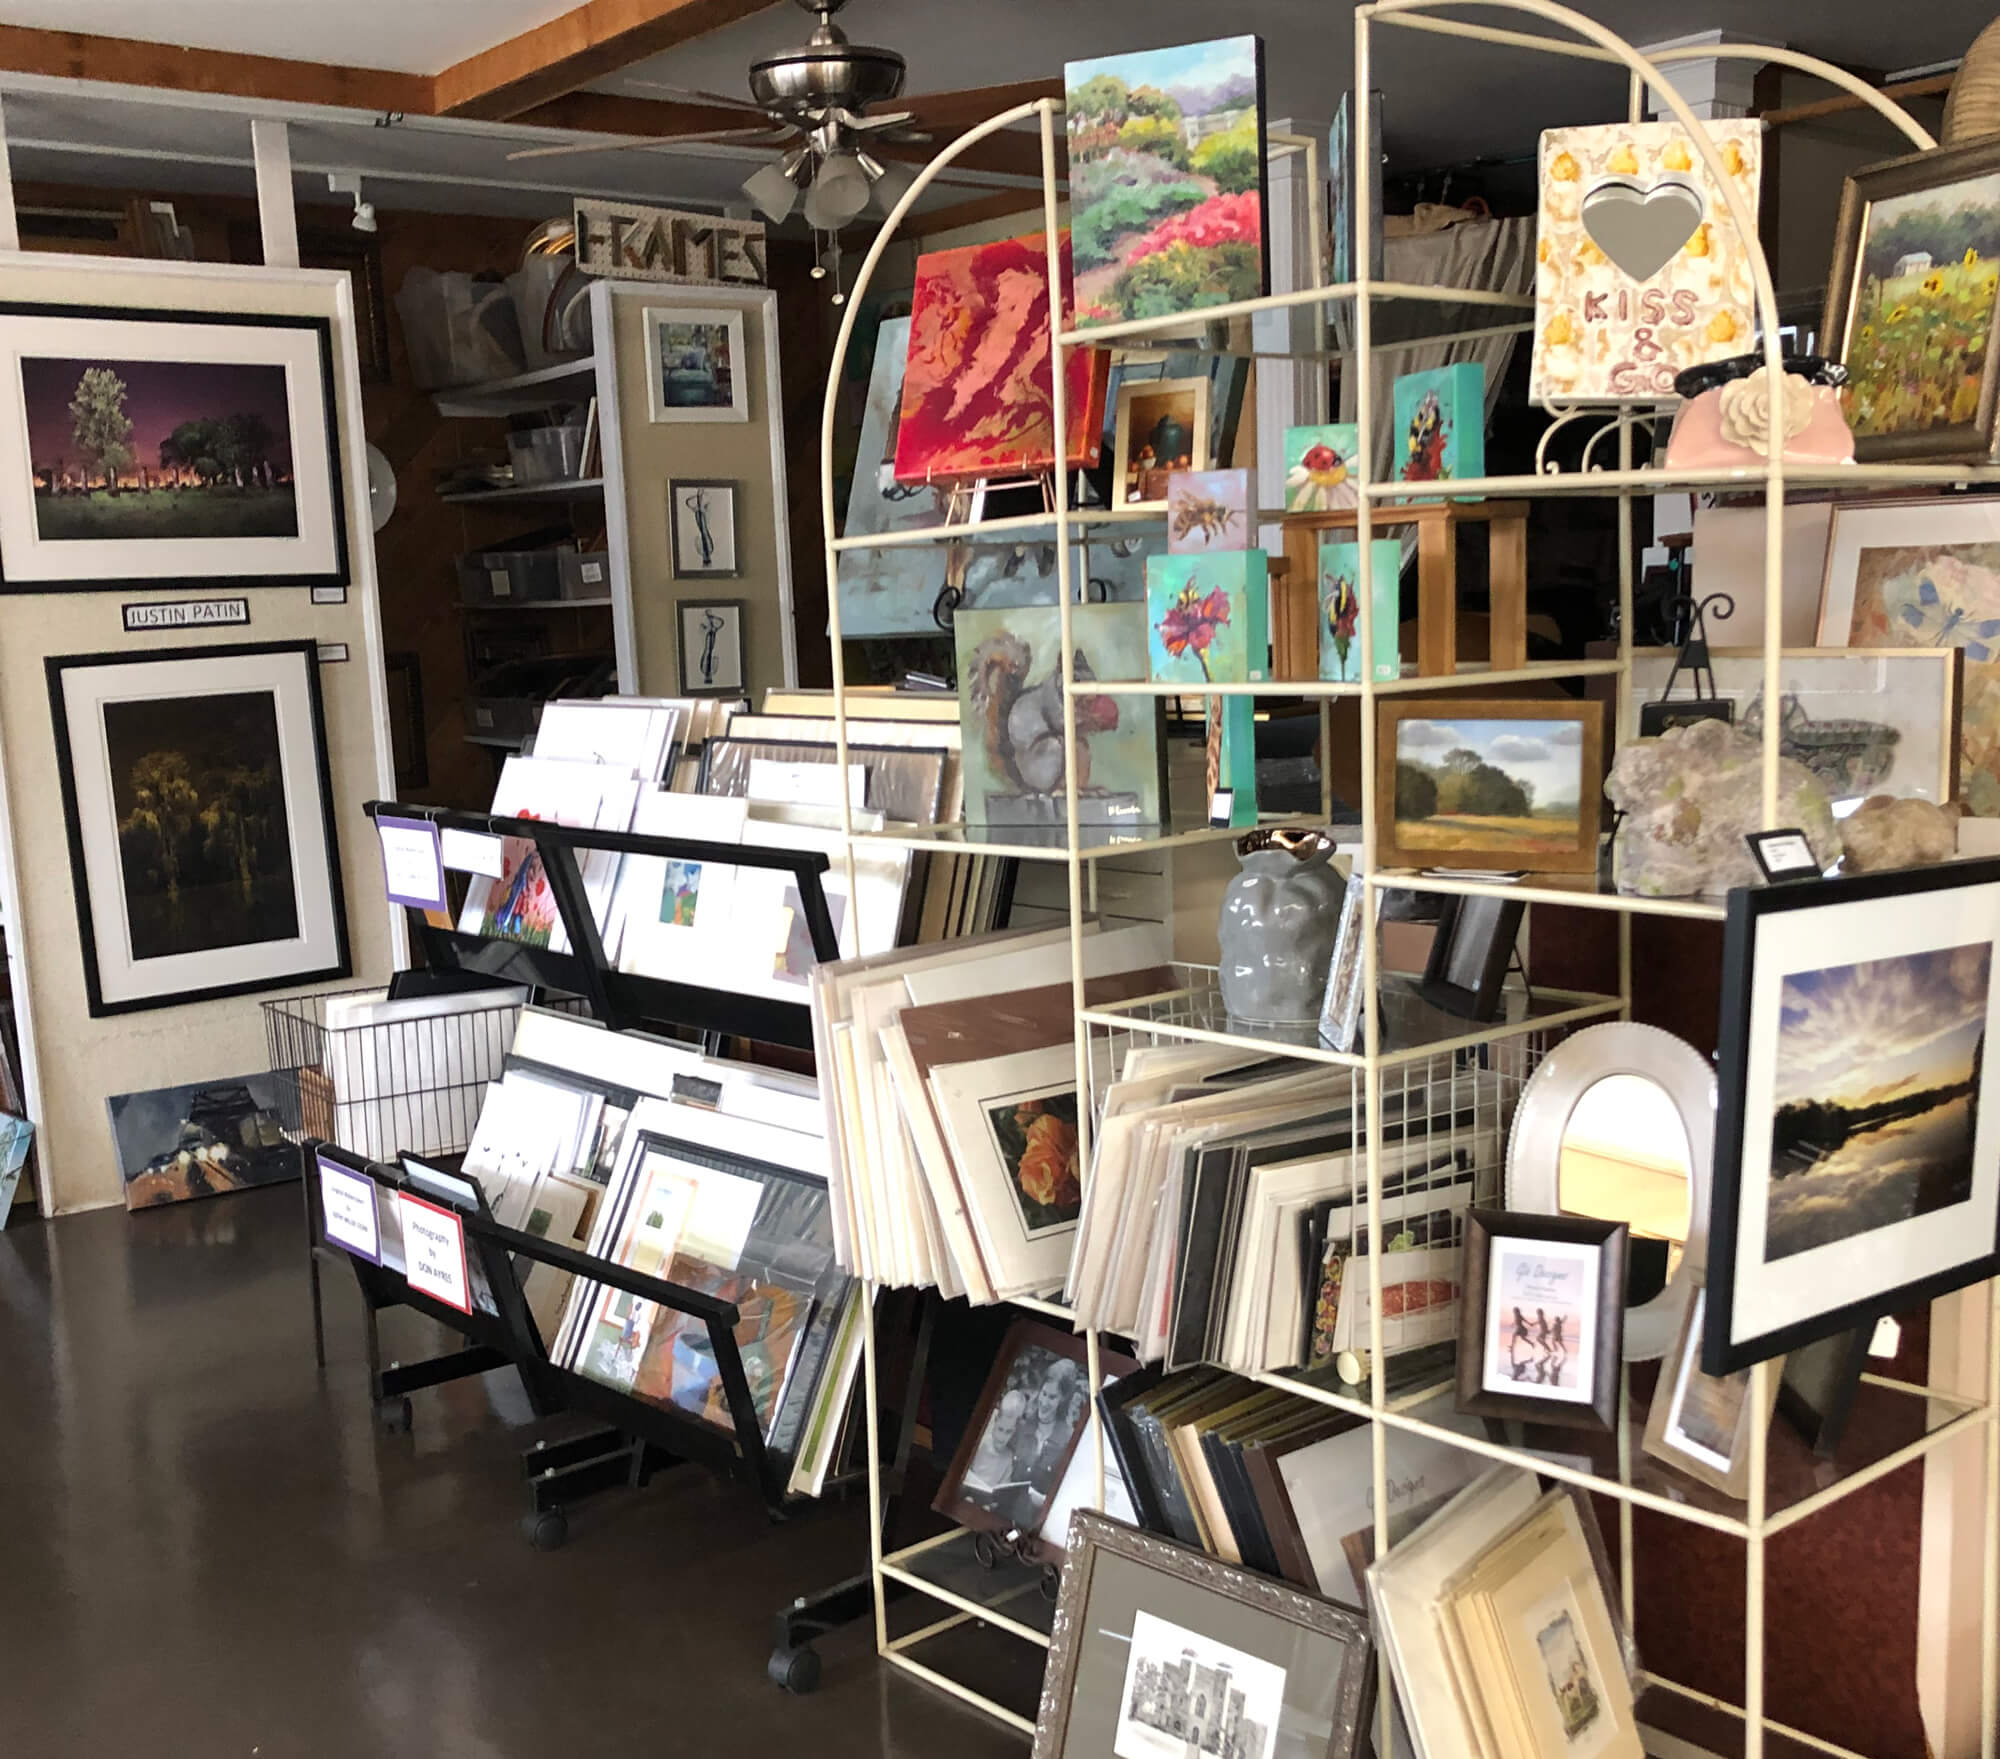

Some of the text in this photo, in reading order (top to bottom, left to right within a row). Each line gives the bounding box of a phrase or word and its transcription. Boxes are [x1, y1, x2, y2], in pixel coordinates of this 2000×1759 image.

[577, 210, 768, 286] FRAMES
[1585, 288, 1698, 326] KISS
[1633, 328, 1663, 361] &
[1608, 361, 1680, 394] GO
[131, 603, 241, 624] JUSTIN PATIN
[412, 1221, 450, 1247] Photography
